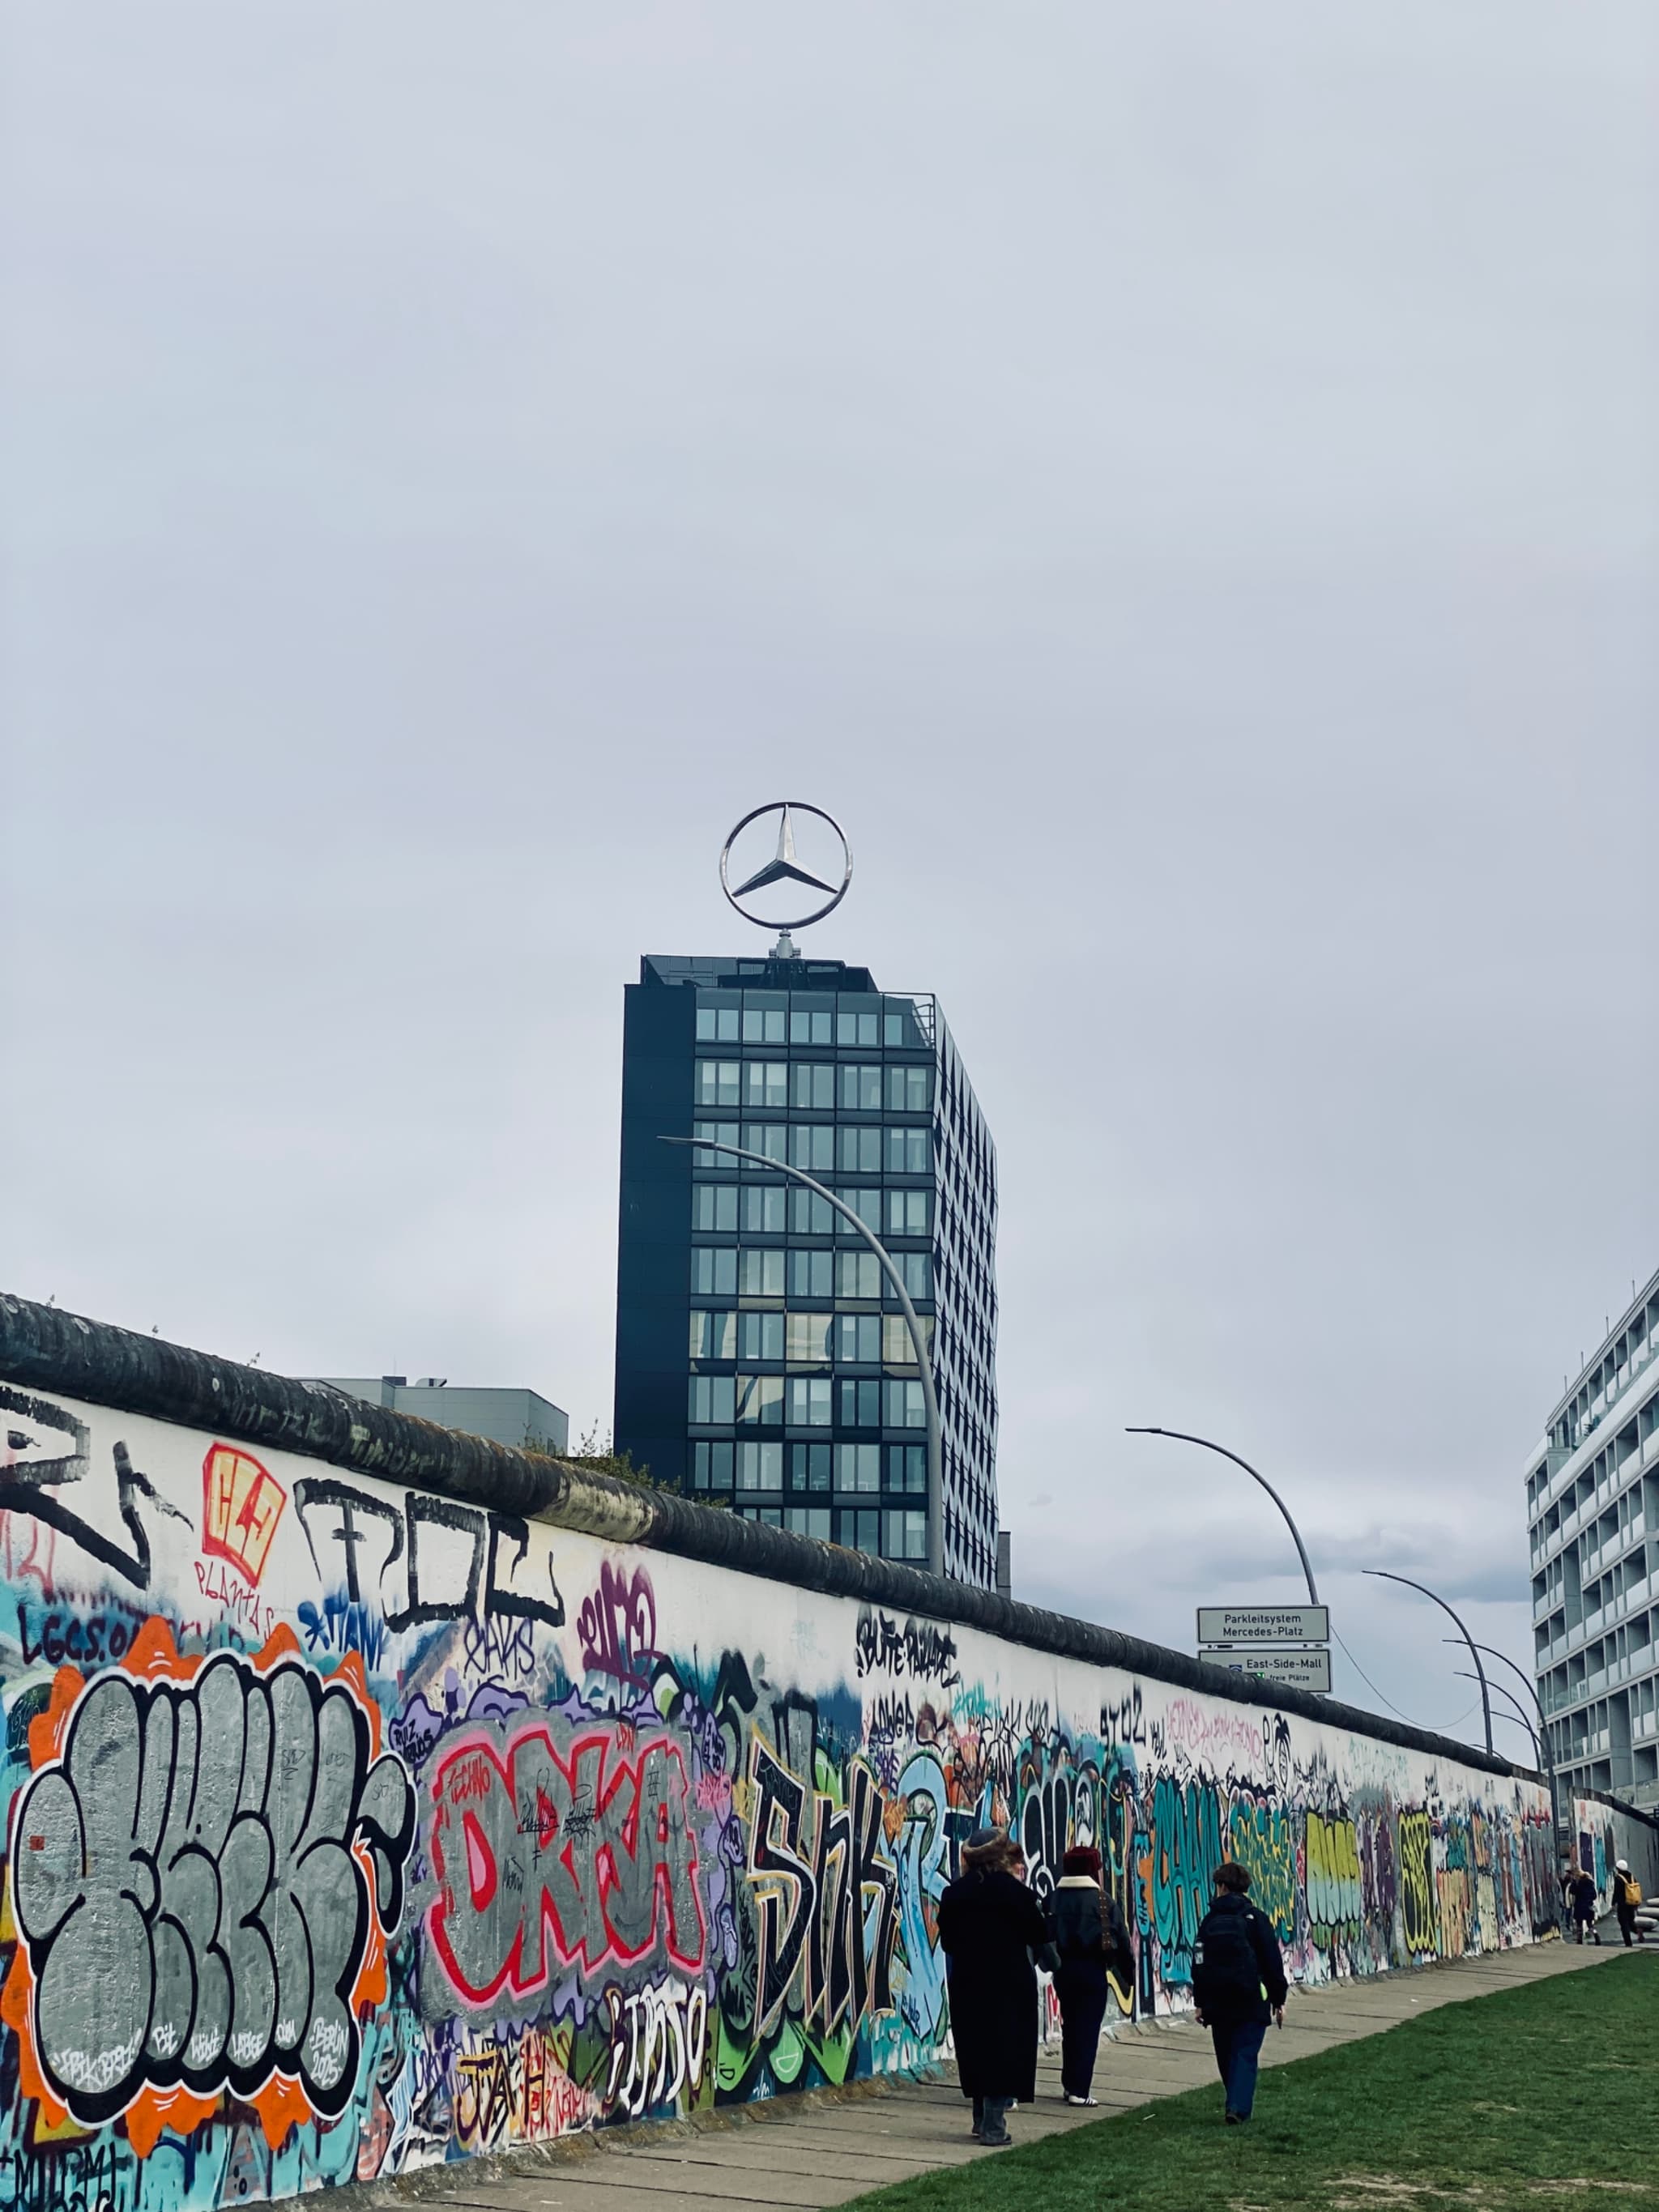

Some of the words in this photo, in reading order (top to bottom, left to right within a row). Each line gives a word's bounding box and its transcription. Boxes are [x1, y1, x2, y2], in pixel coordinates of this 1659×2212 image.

[1225, 1613, 1301, 1625] Parkleitsystem
[1223, 1626, 1303, 1636] Mercedes-Platz
[1247, 1659, 1321, 1669] East-Side-Mall
